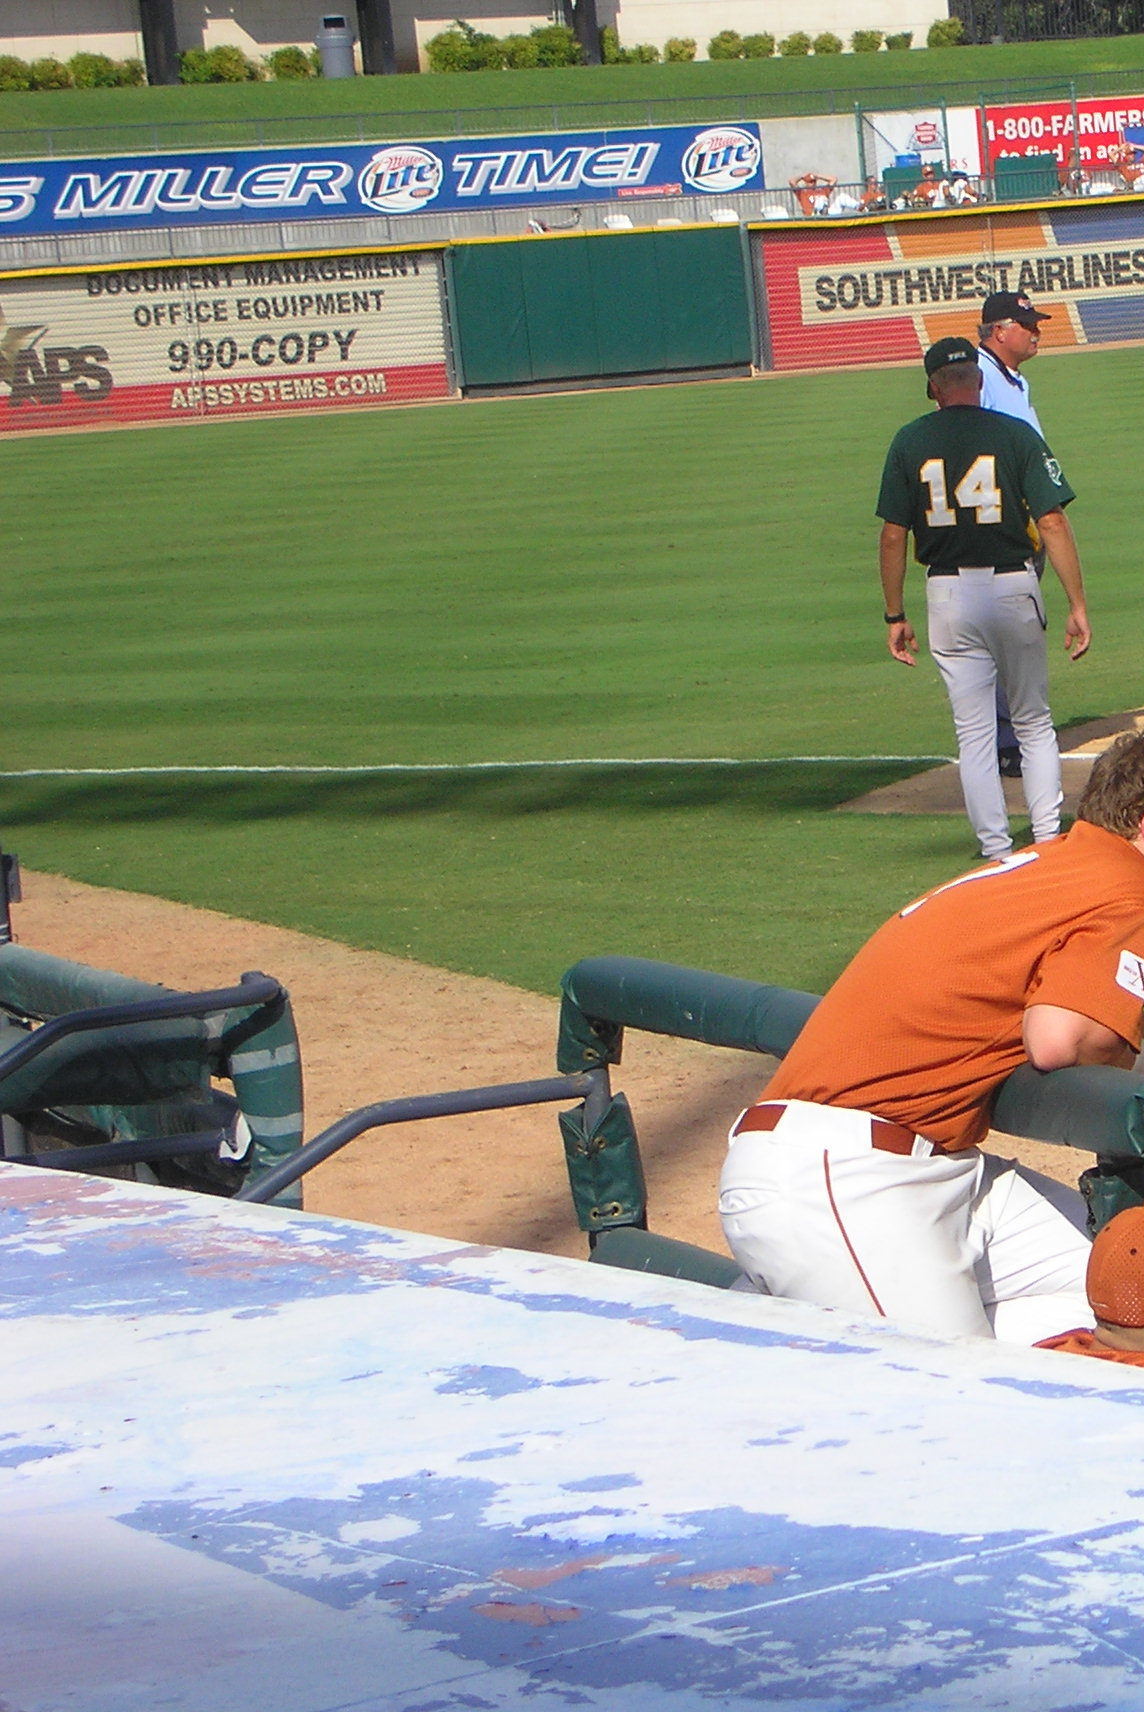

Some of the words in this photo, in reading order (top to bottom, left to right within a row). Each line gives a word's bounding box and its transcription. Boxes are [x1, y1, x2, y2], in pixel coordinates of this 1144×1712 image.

[53, 161, 352, 219] MILLER
[451, 142, 660, 197] TIME!
[87, 265, 235, 297] DOCUMENT
[245, 256, 423, 287] MANAGEMENT
[815, 261, 1013, 312] SOUTHWEST
[133, 301, 229, 327] OFFICE
[237, 289, 385, 321] EQUIPMENT
[168, 328, 359, 373] 990-COPY
[170, 372, 387, 410] APSSYSTEMS.COM
[920, 455, 1002, 527] 14
